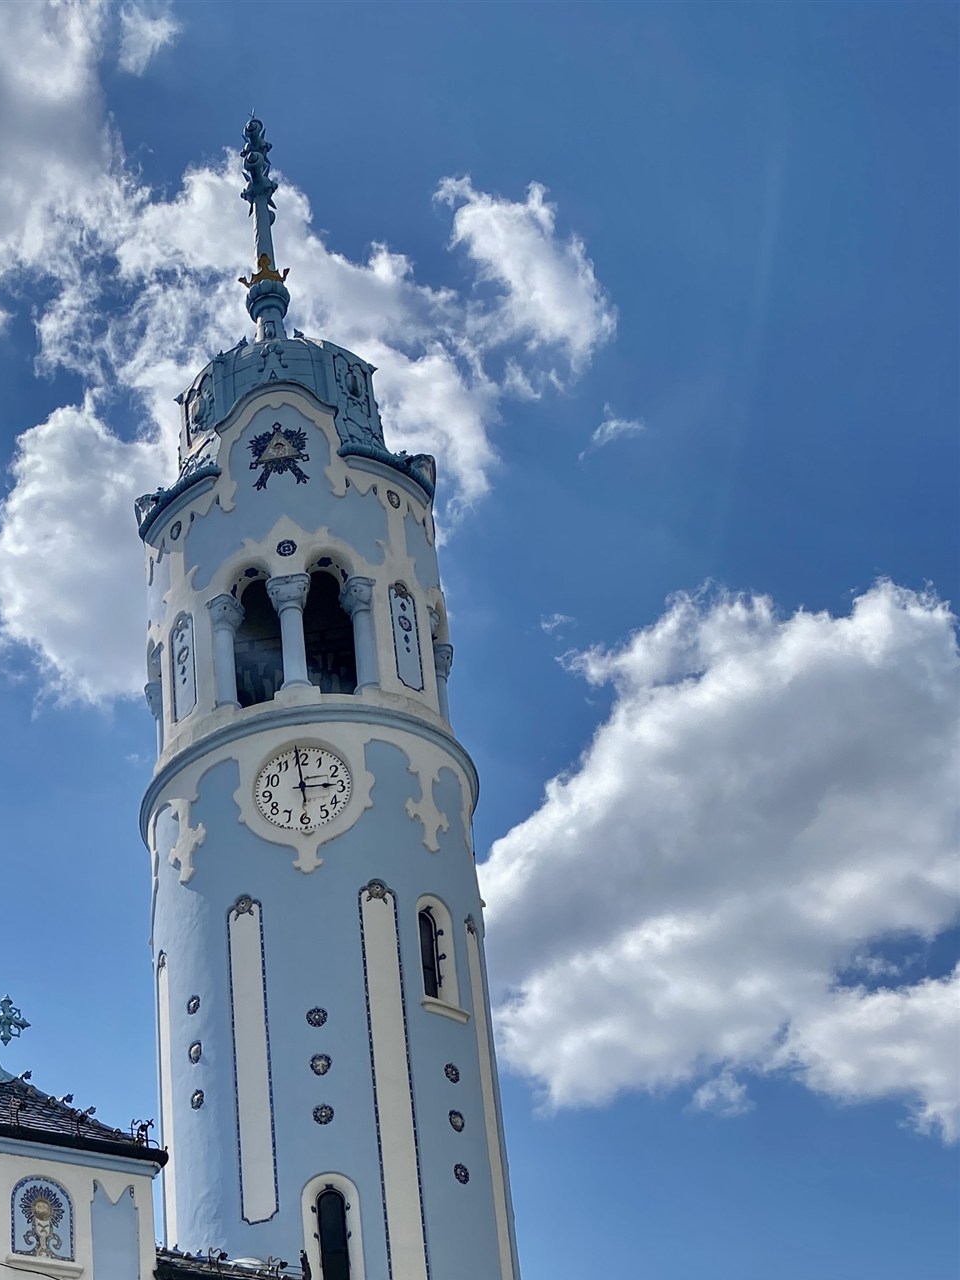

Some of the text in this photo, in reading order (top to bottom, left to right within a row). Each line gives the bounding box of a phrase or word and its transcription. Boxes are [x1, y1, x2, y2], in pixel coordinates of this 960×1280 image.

[293, 752, 309, 766] 12
[316, 757, 322, 769] 1
[277, 760, 289, 773] 11
[329, 764, 339, 778] 2
[265, 773, 280, 788] 10
[336, 779, 346, 793] 3
[262, 790, 273, 804] 9
[330, 794, 341, 810] 4
[270, 801, 280, 816] 8
[320, 804, 330, 819] 5
[283, 809, 292, 823] 7
[300, 812, 311, 825] 6
